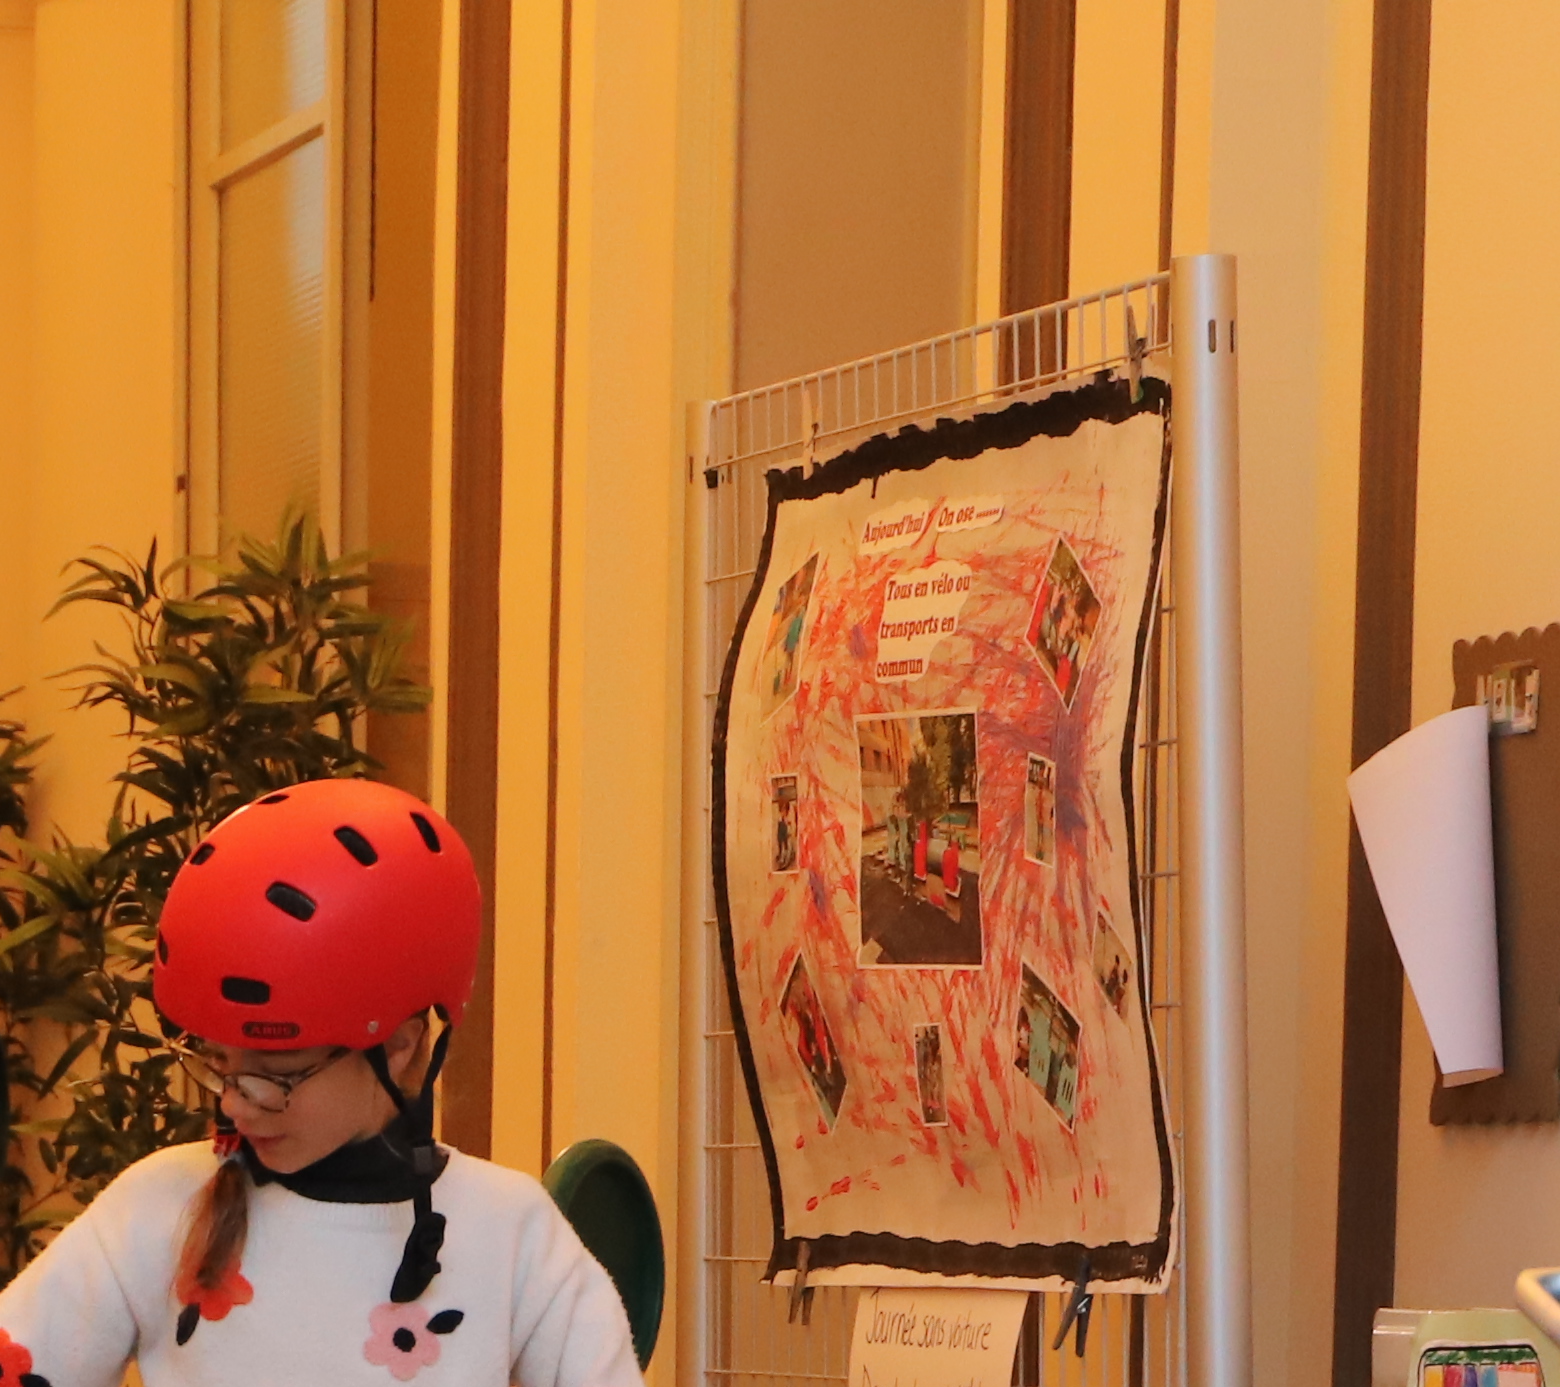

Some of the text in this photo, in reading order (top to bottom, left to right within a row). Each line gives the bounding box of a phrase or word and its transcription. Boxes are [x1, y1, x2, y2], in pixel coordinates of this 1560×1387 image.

[862, 505, 975, 546] Aujourd'hui On ose
[886, 572, 971, 601] Tous en vélo ou
[880, 616, 955, 641] transports en
[876, 658, 923, 678] commun
[865, 1287, 992, 1350] Journée sans voiture
